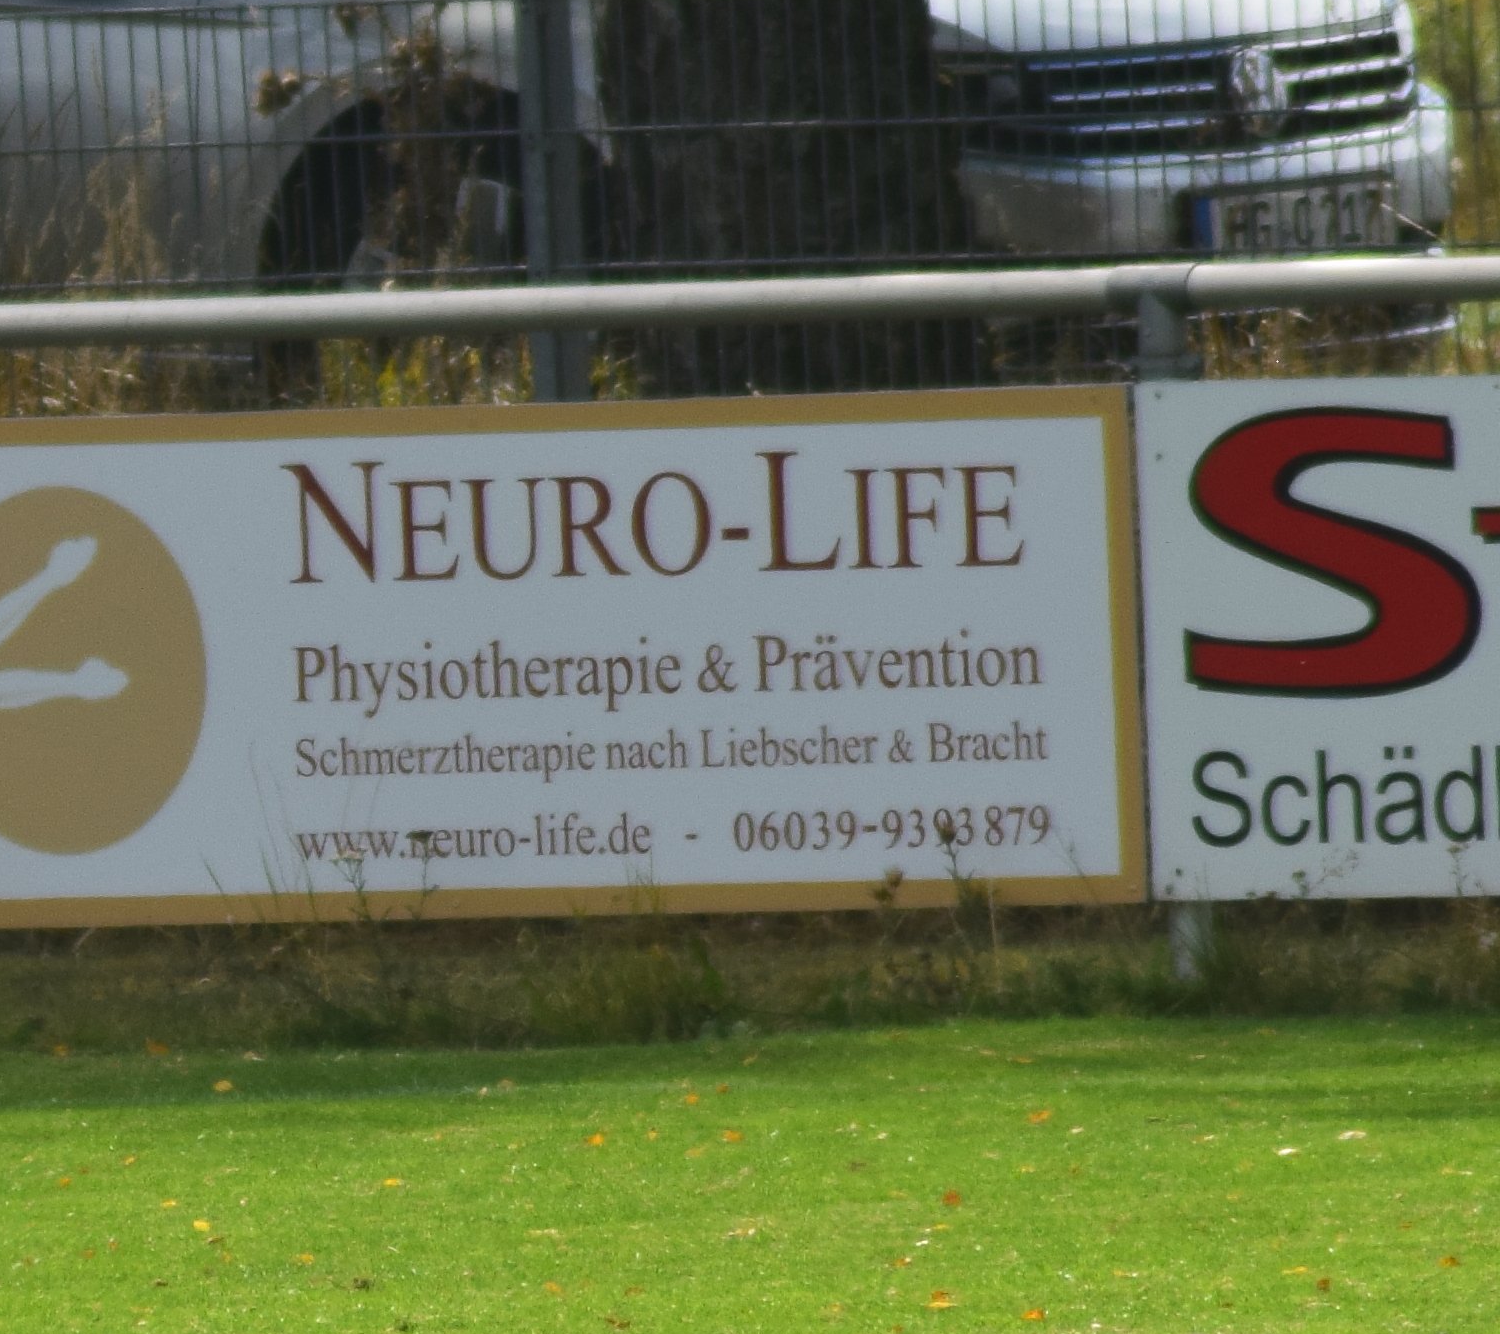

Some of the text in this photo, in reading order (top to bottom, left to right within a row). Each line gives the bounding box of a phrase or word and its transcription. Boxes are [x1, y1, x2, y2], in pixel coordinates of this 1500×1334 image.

[281, 450, 1024, 584] NEURO-LIFE
[293, 628, 1043, 719] Physiotherapie & Prävention
[295, 719, 1049, 784] Schmerztherapie nach Liebscher & Bracht
[295, 811, 652, 860] www.neuro-life.de
